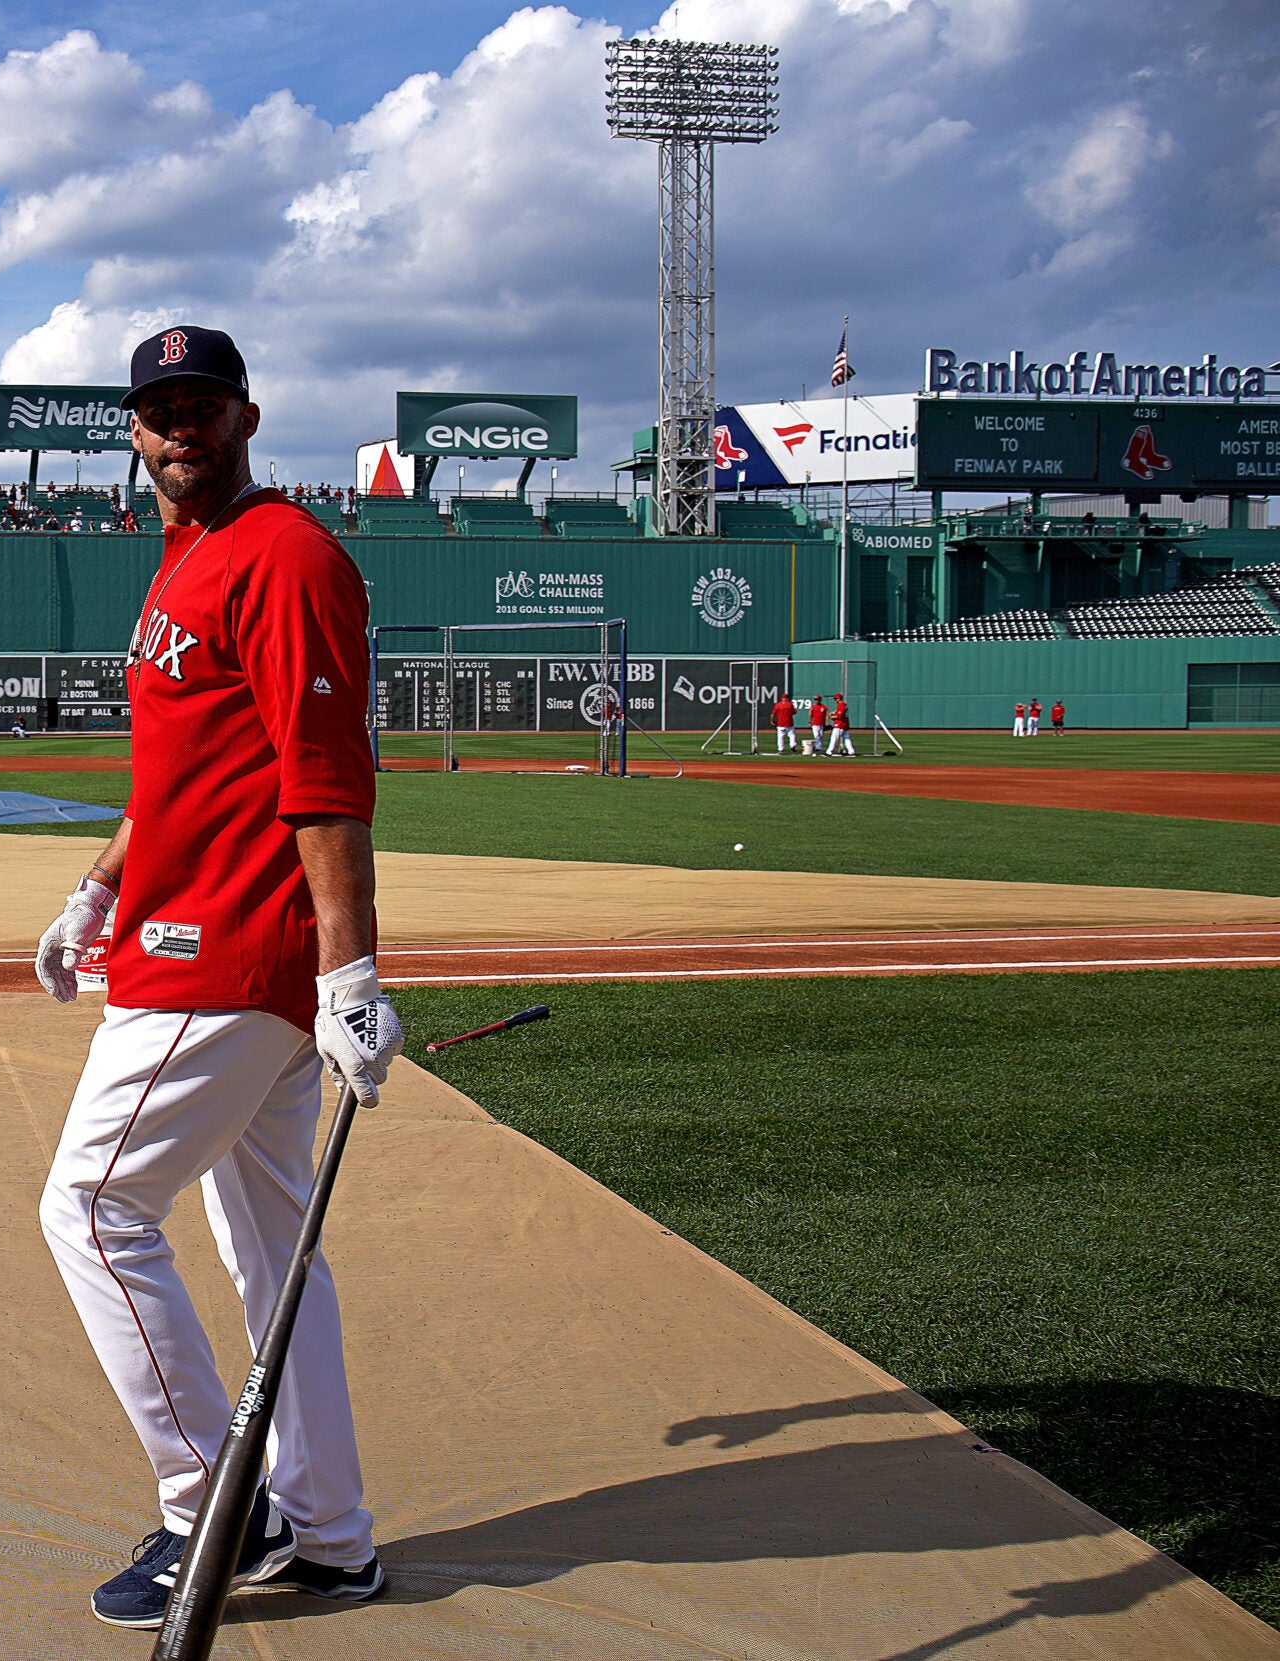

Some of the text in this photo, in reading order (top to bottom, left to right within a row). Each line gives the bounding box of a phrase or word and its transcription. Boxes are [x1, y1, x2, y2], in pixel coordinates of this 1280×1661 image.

[158, 330, 188, 366] B
[44, 400, 134, 427] Nation
[1133, 408, 1158, 418] 4:36
[974, 416, 1046, 432] WELCOME
[1237, 420, 1280, 434] AMER
[86, 429, 111, 440] Car
[1000, 437, 1018, 452] TO
[1220, 441, 1280, 455] MOST BE
[954, 459, 1063, 474] FENWAY PARK
[1236, 462, 1280, 476] BALL
[864, 535, 933, 549] ABIOMED
[538, 573, 604, 586] PAN-MASS
[538, 587, 604, 599] CHALLENGE
[692, 575, 710, 606] IBEW
[709, 567, 732, 580] 103
[735, 577, 752, 606] NECA
[495, 604, 604, 615] 2018 GOAL: $52 MILLION
[81, 660, 127, 668] FENW
[403, 661, 490, 669] NATIONA LEAGUE
[60, 669, 68, 678] P
[109, 669, 115, 677] 2
[117, 669, 123, 677] 3
[405, 670, 534, 678] R P R P R
[74, 679, 95, 688] MINN
[495, 680, 512, 688] CHC
[60, 690, 99, 698] 22 BOSTON
[496, 688, 511, 696] STL
[698, 685, 778, 705] OPTUM
[16, 705, 37, 713] 1898
[546, 697, 655, 710] Since 1866
[60, 708, 71, 716] AT
[71, 708, 86, 716] BAT
[91, 708, 113, 716] BALL
[366, 1001, 379, 1051] adidas
[230, 1364, 266, 1438] HICKORY
